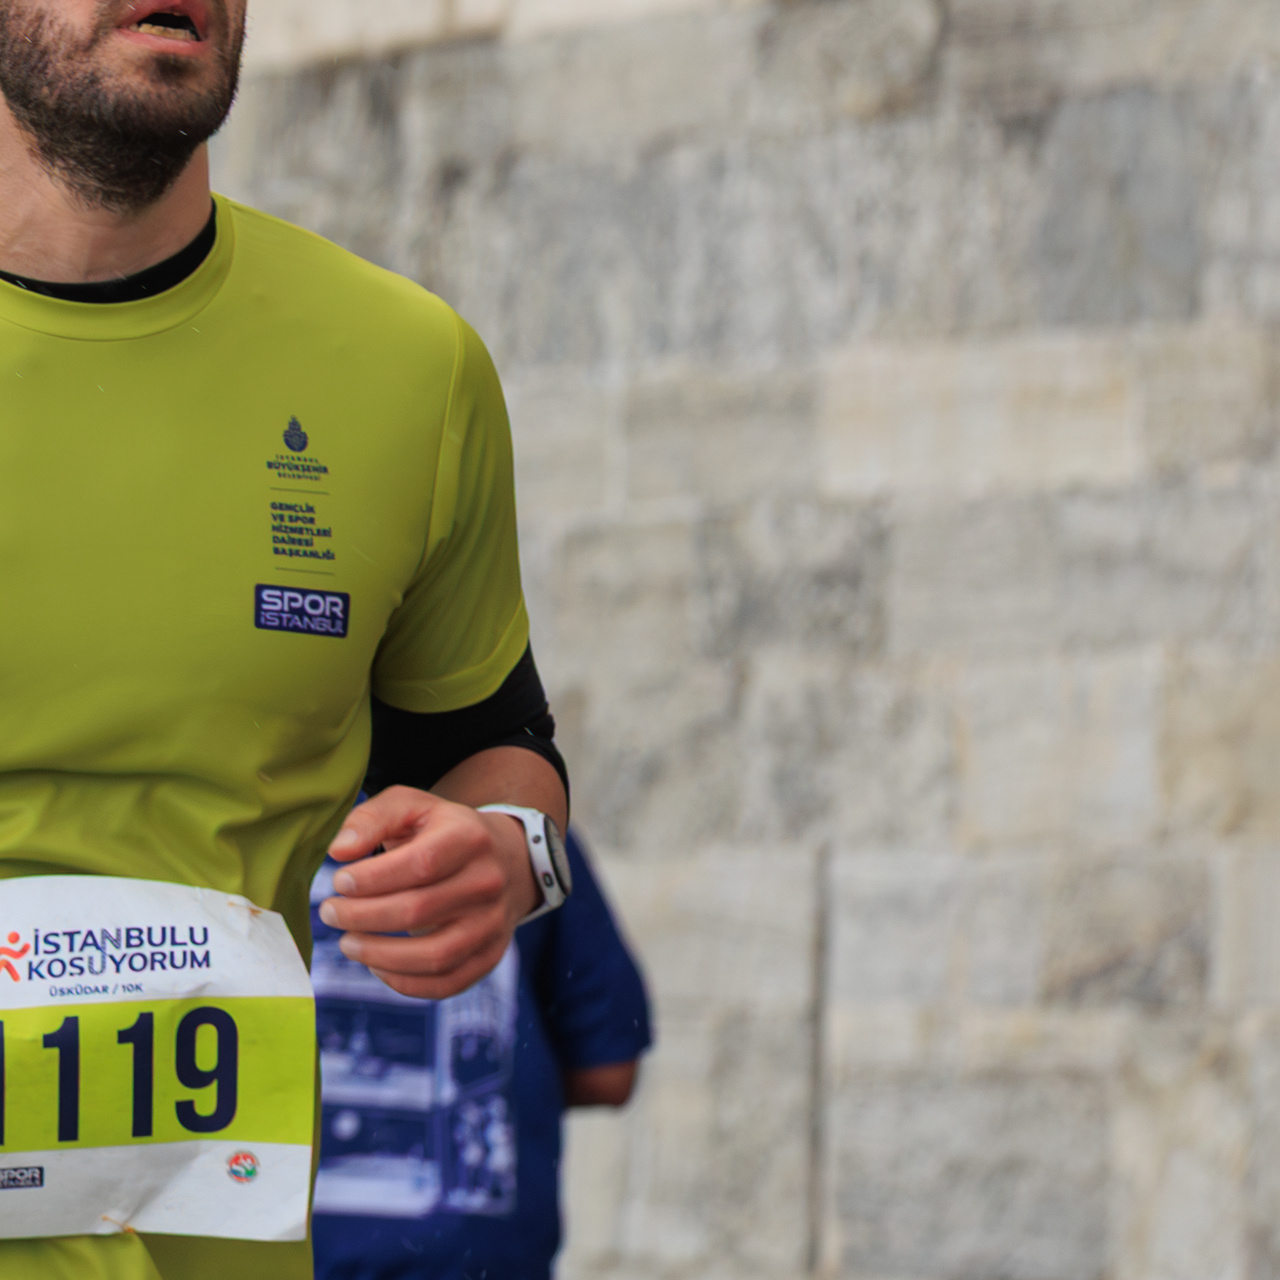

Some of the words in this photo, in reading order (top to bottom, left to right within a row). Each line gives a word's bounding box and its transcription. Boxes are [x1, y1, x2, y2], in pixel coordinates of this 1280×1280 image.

[287, 514, 315, 524] SPOR
[261, 588, 344, 619] SPOR
[34, 925, 209, 956] İSTANBULU
[49, 984, 109, 997] ÜSKÜDAR
[122, 983, 144, 993] 10K
